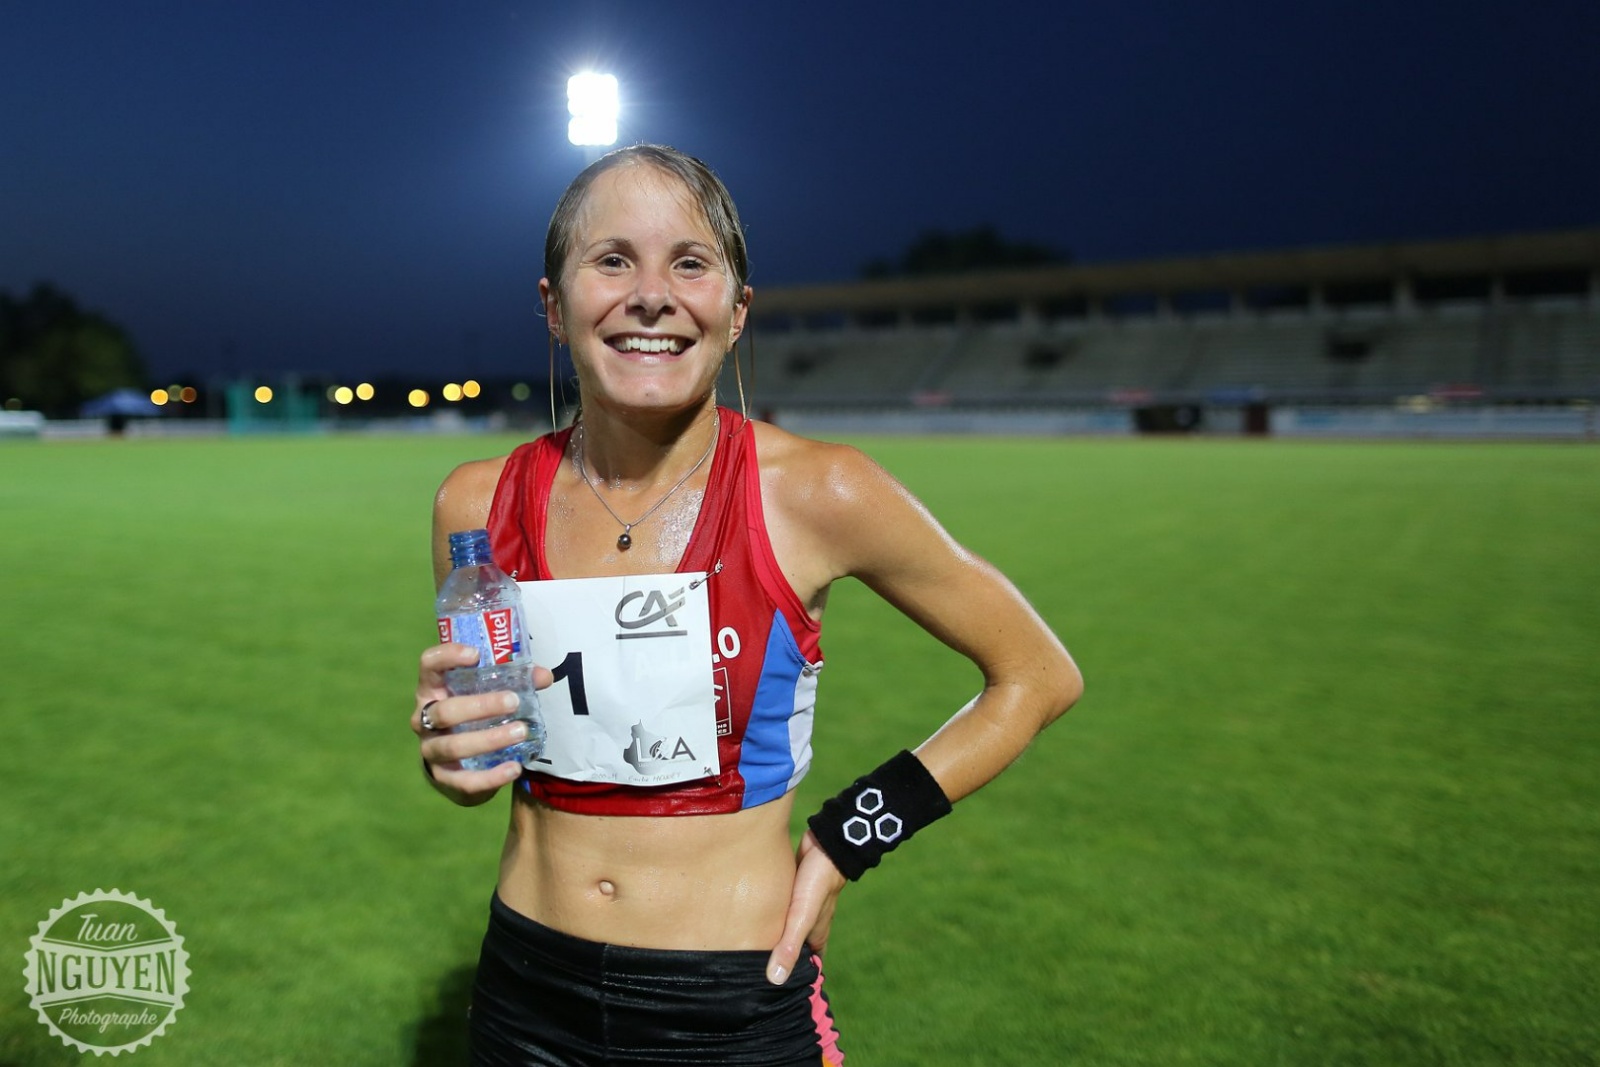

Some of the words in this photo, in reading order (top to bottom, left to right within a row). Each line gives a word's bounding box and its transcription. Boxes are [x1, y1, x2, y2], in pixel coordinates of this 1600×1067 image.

[438, 621, 450, 643] tel
[489, 611, 511, 661] Vittel
[551, 651, 589, 715] 1
